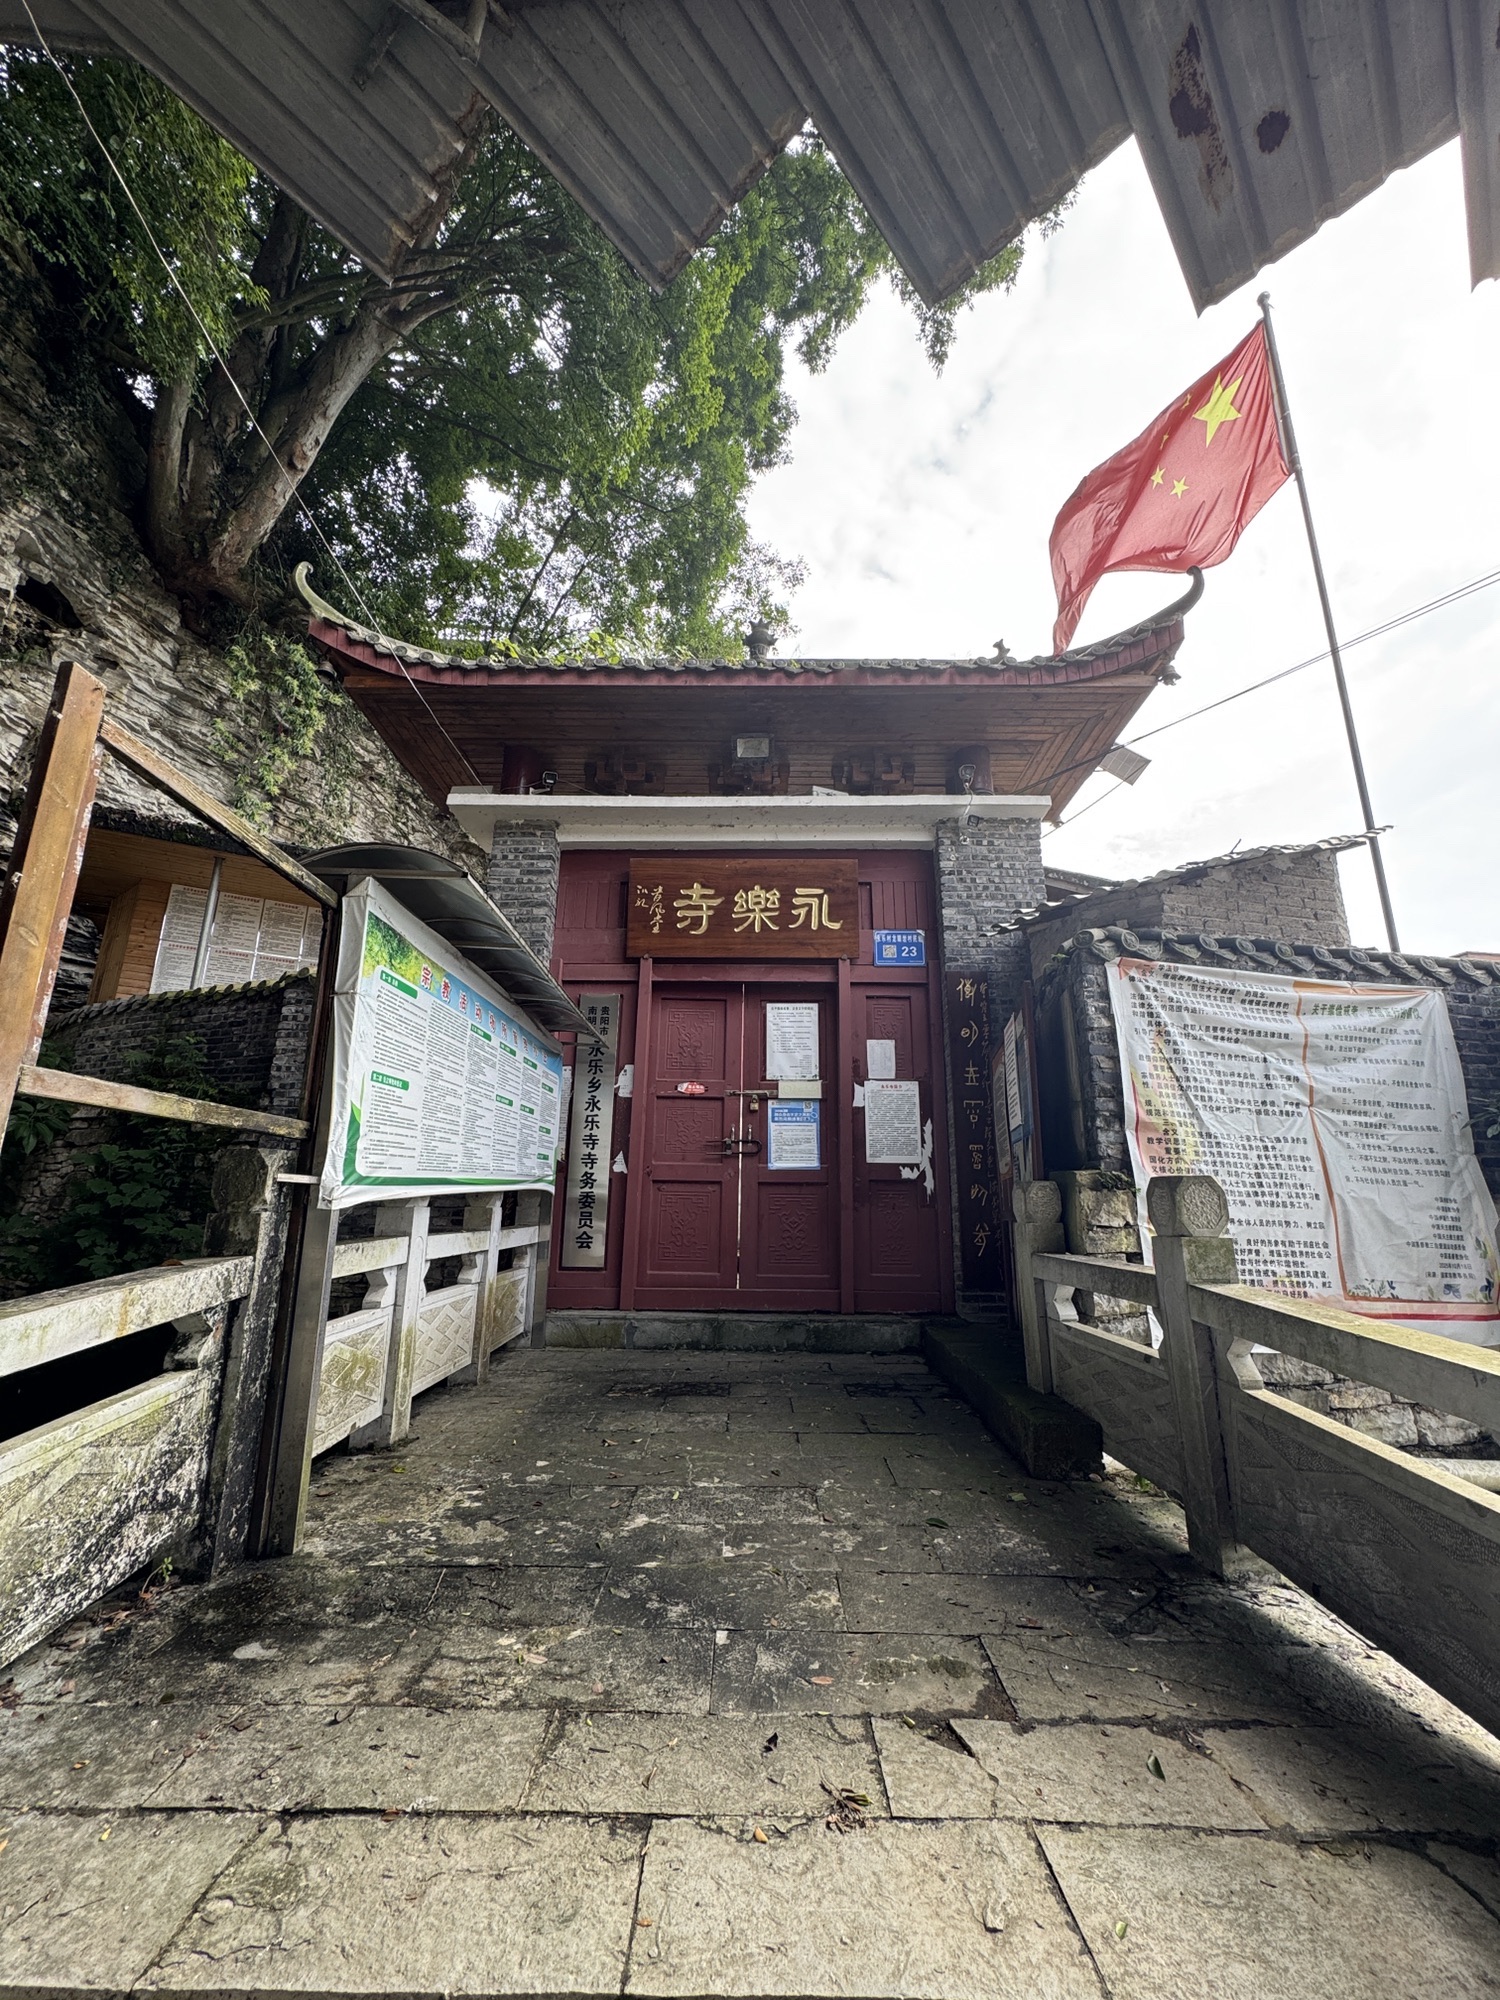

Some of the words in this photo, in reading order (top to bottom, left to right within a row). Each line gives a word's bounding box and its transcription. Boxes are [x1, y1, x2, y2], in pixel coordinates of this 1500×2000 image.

[901, 946, 917, 957] 23
[588, 1006, 598, 1029] 南明
[600, 1006, 610, 1036] 贵阳市
[576, 1040, 605, 1250] 永乐乡永乐寺寺务委员会
